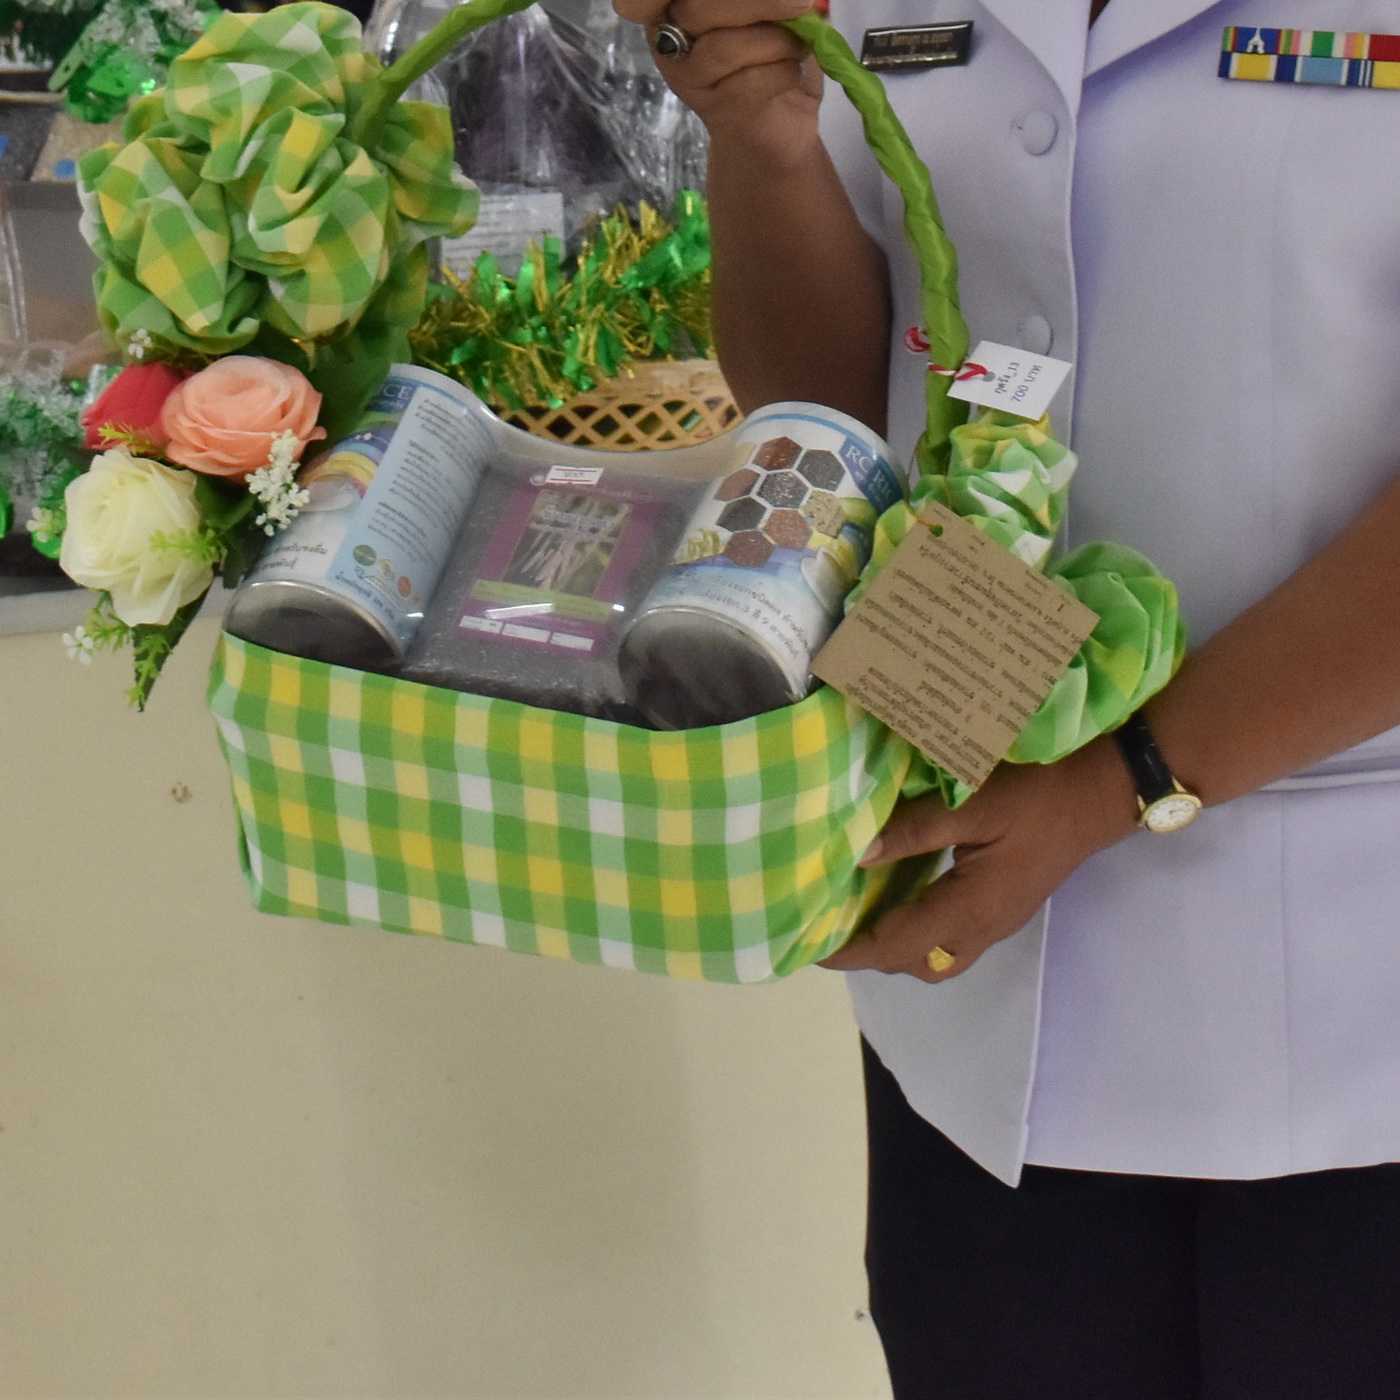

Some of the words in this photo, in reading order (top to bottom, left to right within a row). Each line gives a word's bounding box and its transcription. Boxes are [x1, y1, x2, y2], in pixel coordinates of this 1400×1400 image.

[1010, 384, 1029, 402] 700
[1024, 364, 1043, 383] บาท
[846, 445, 873, 474] RC
